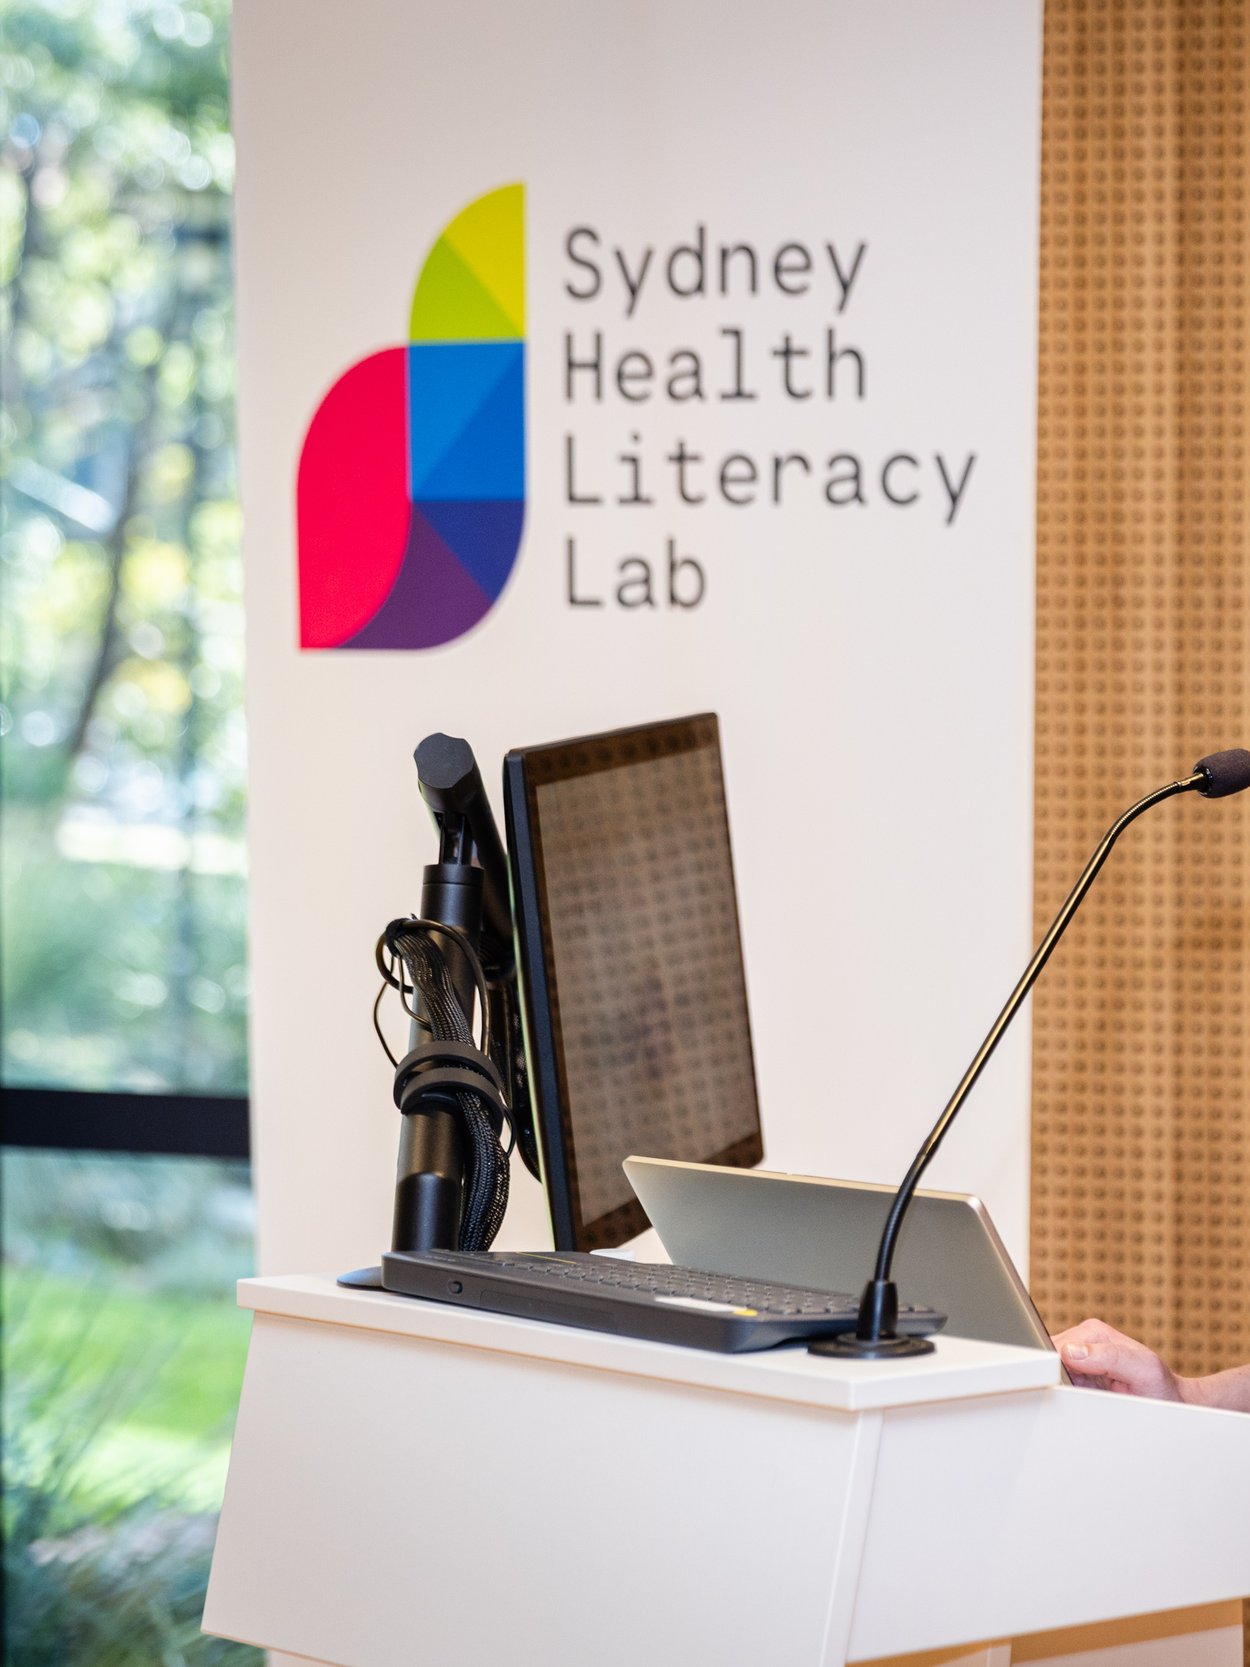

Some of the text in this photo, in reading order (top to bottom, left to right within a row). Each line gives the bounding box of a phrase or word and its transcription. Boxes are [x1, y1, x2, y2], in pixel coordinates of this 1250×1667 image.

[564, 223, 868, 319] Sydney
[564, 326, 867, 404] Health
[564, 432, 977, 527] Literacy
[564, 536, 708, 611] Lab
